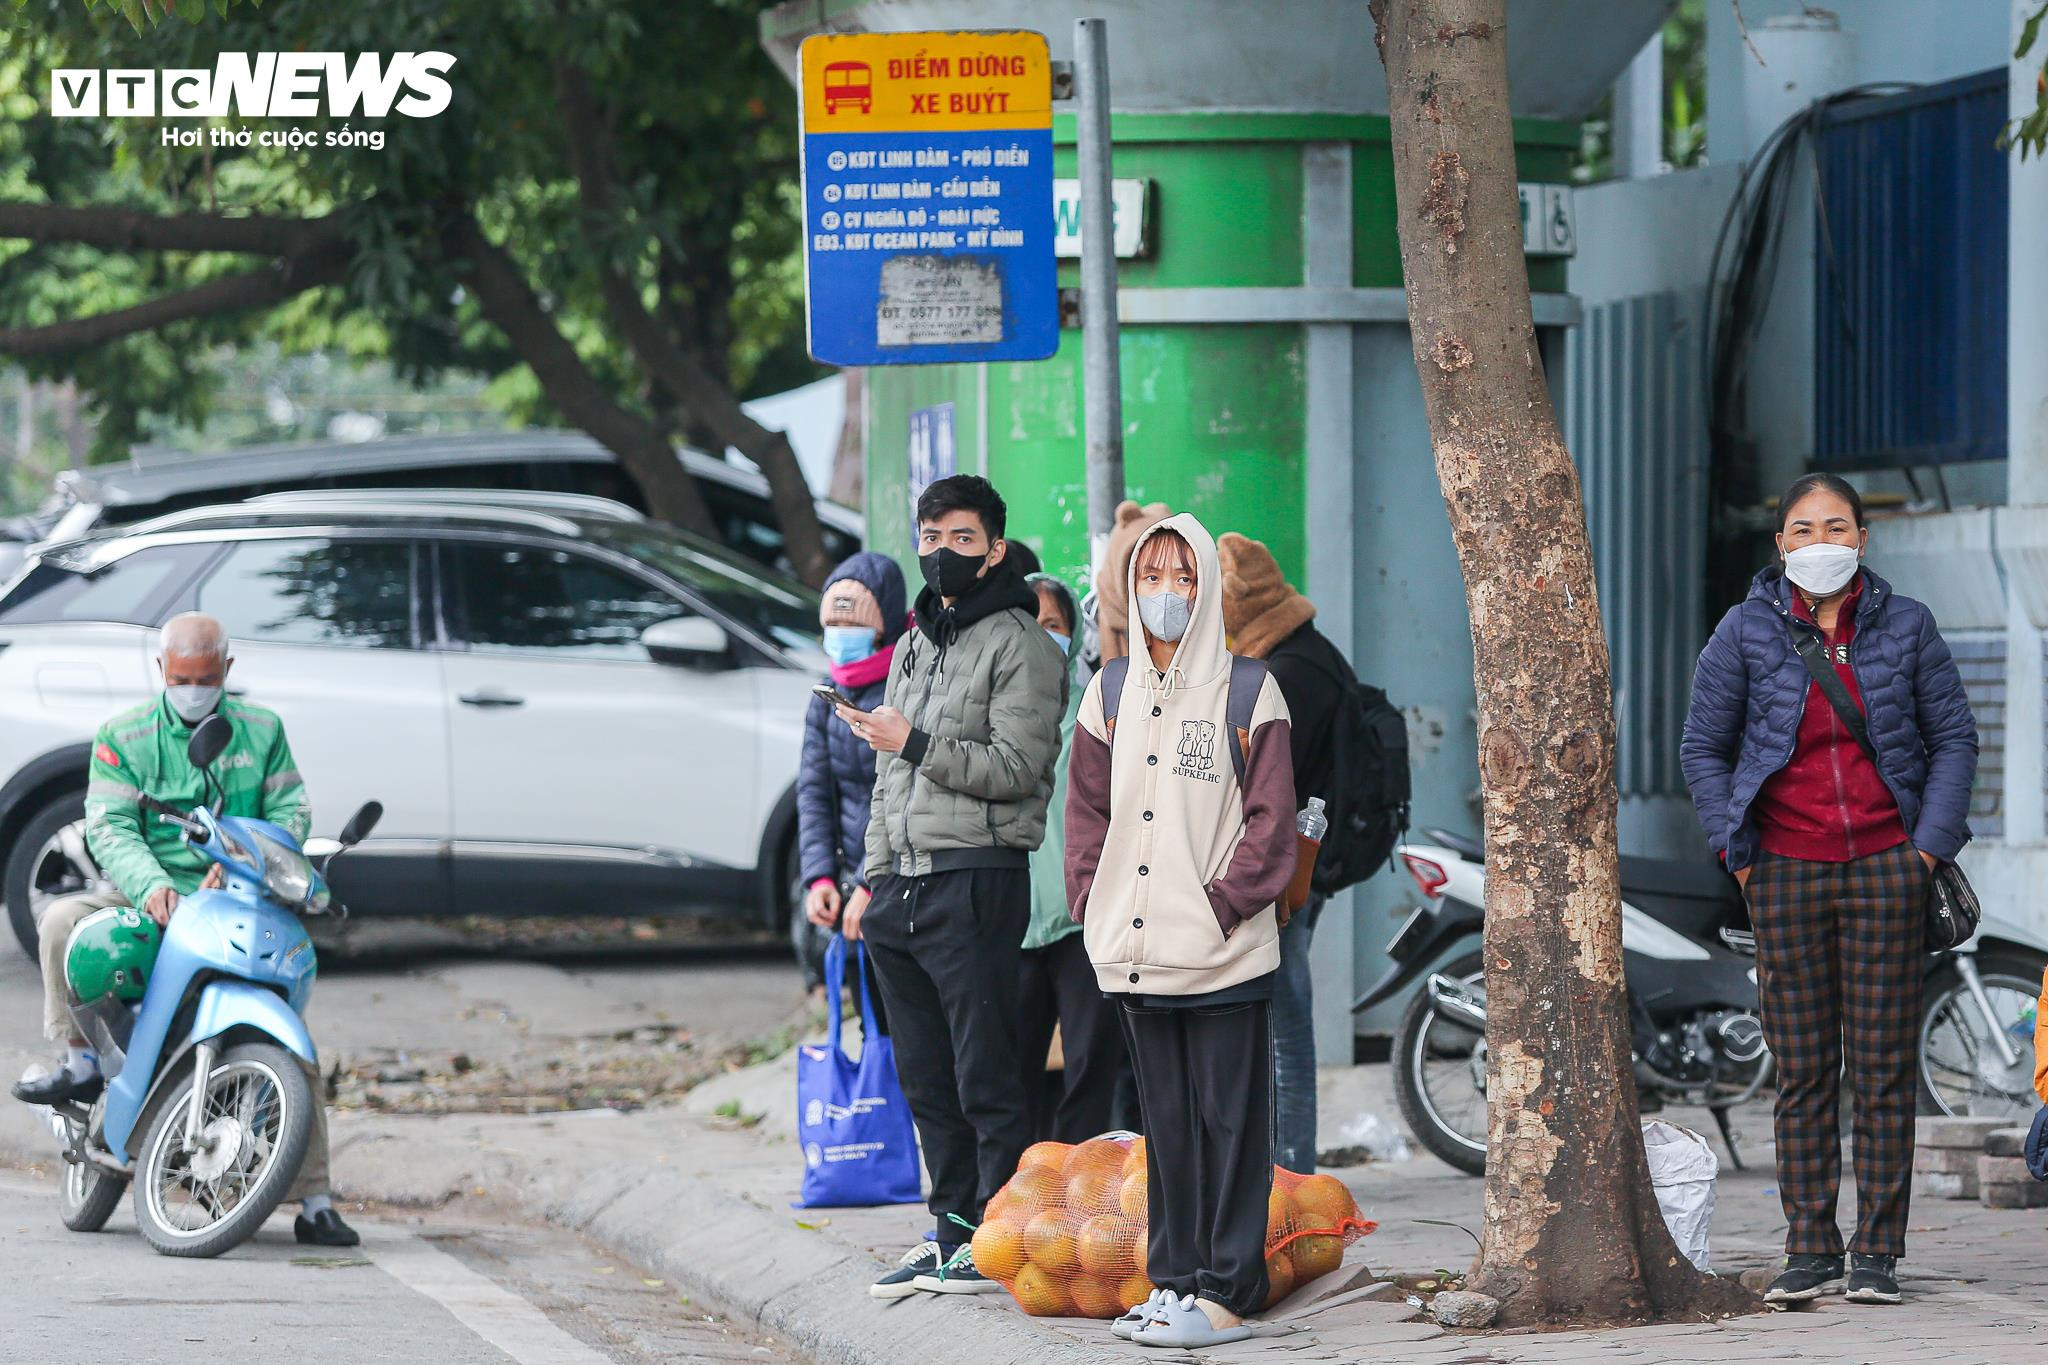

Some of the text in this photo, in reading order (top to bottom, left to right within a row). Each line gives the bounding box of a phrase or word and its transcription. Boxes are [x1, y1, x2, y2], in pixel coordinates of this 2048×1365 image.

[888, 48, 1025, 79] ĐIỂM DỪNG
[911, 86, 1010, 114] XE BUÝT
[879, 150, 913, 168] LINH
[962, 146, 992, 167] PHÚ
[870, 182, 900, 199] LINH
[843, 211, 861, 228] CV
[873, 232, 918, 249] OCEAN
[920, 231, 956, 249] PARK
[1171, 766, 1221, 784] SUPKELHC
